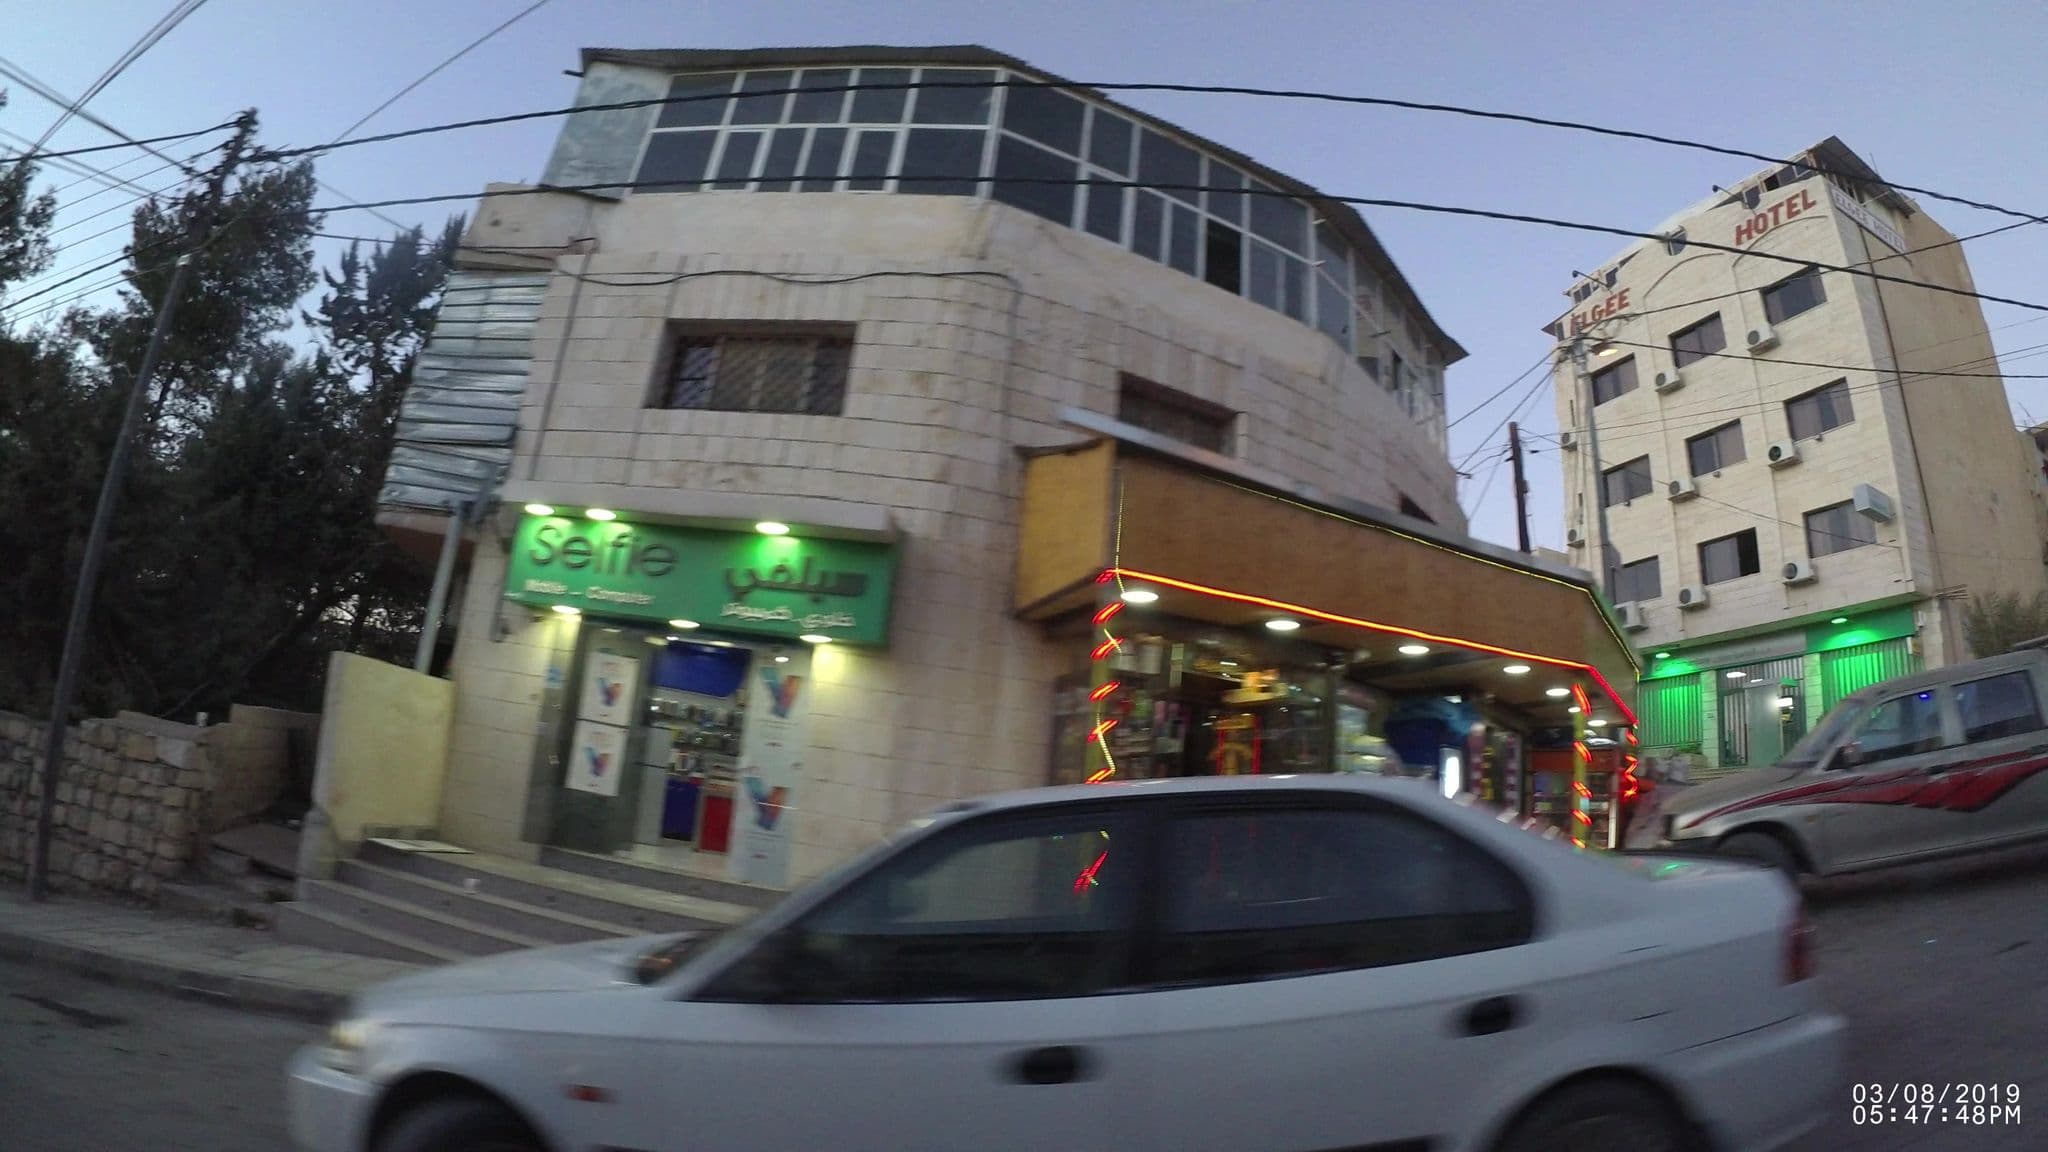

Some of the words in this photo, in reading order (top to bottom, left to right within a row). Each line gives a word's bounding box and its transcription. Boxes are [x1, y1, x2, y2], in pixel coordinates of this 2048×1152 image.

[1735, 188, 1817, 247] HOTEL
[530, 524, 678, 577] Selfie
[722, 556, 868, 604] سيلفي
